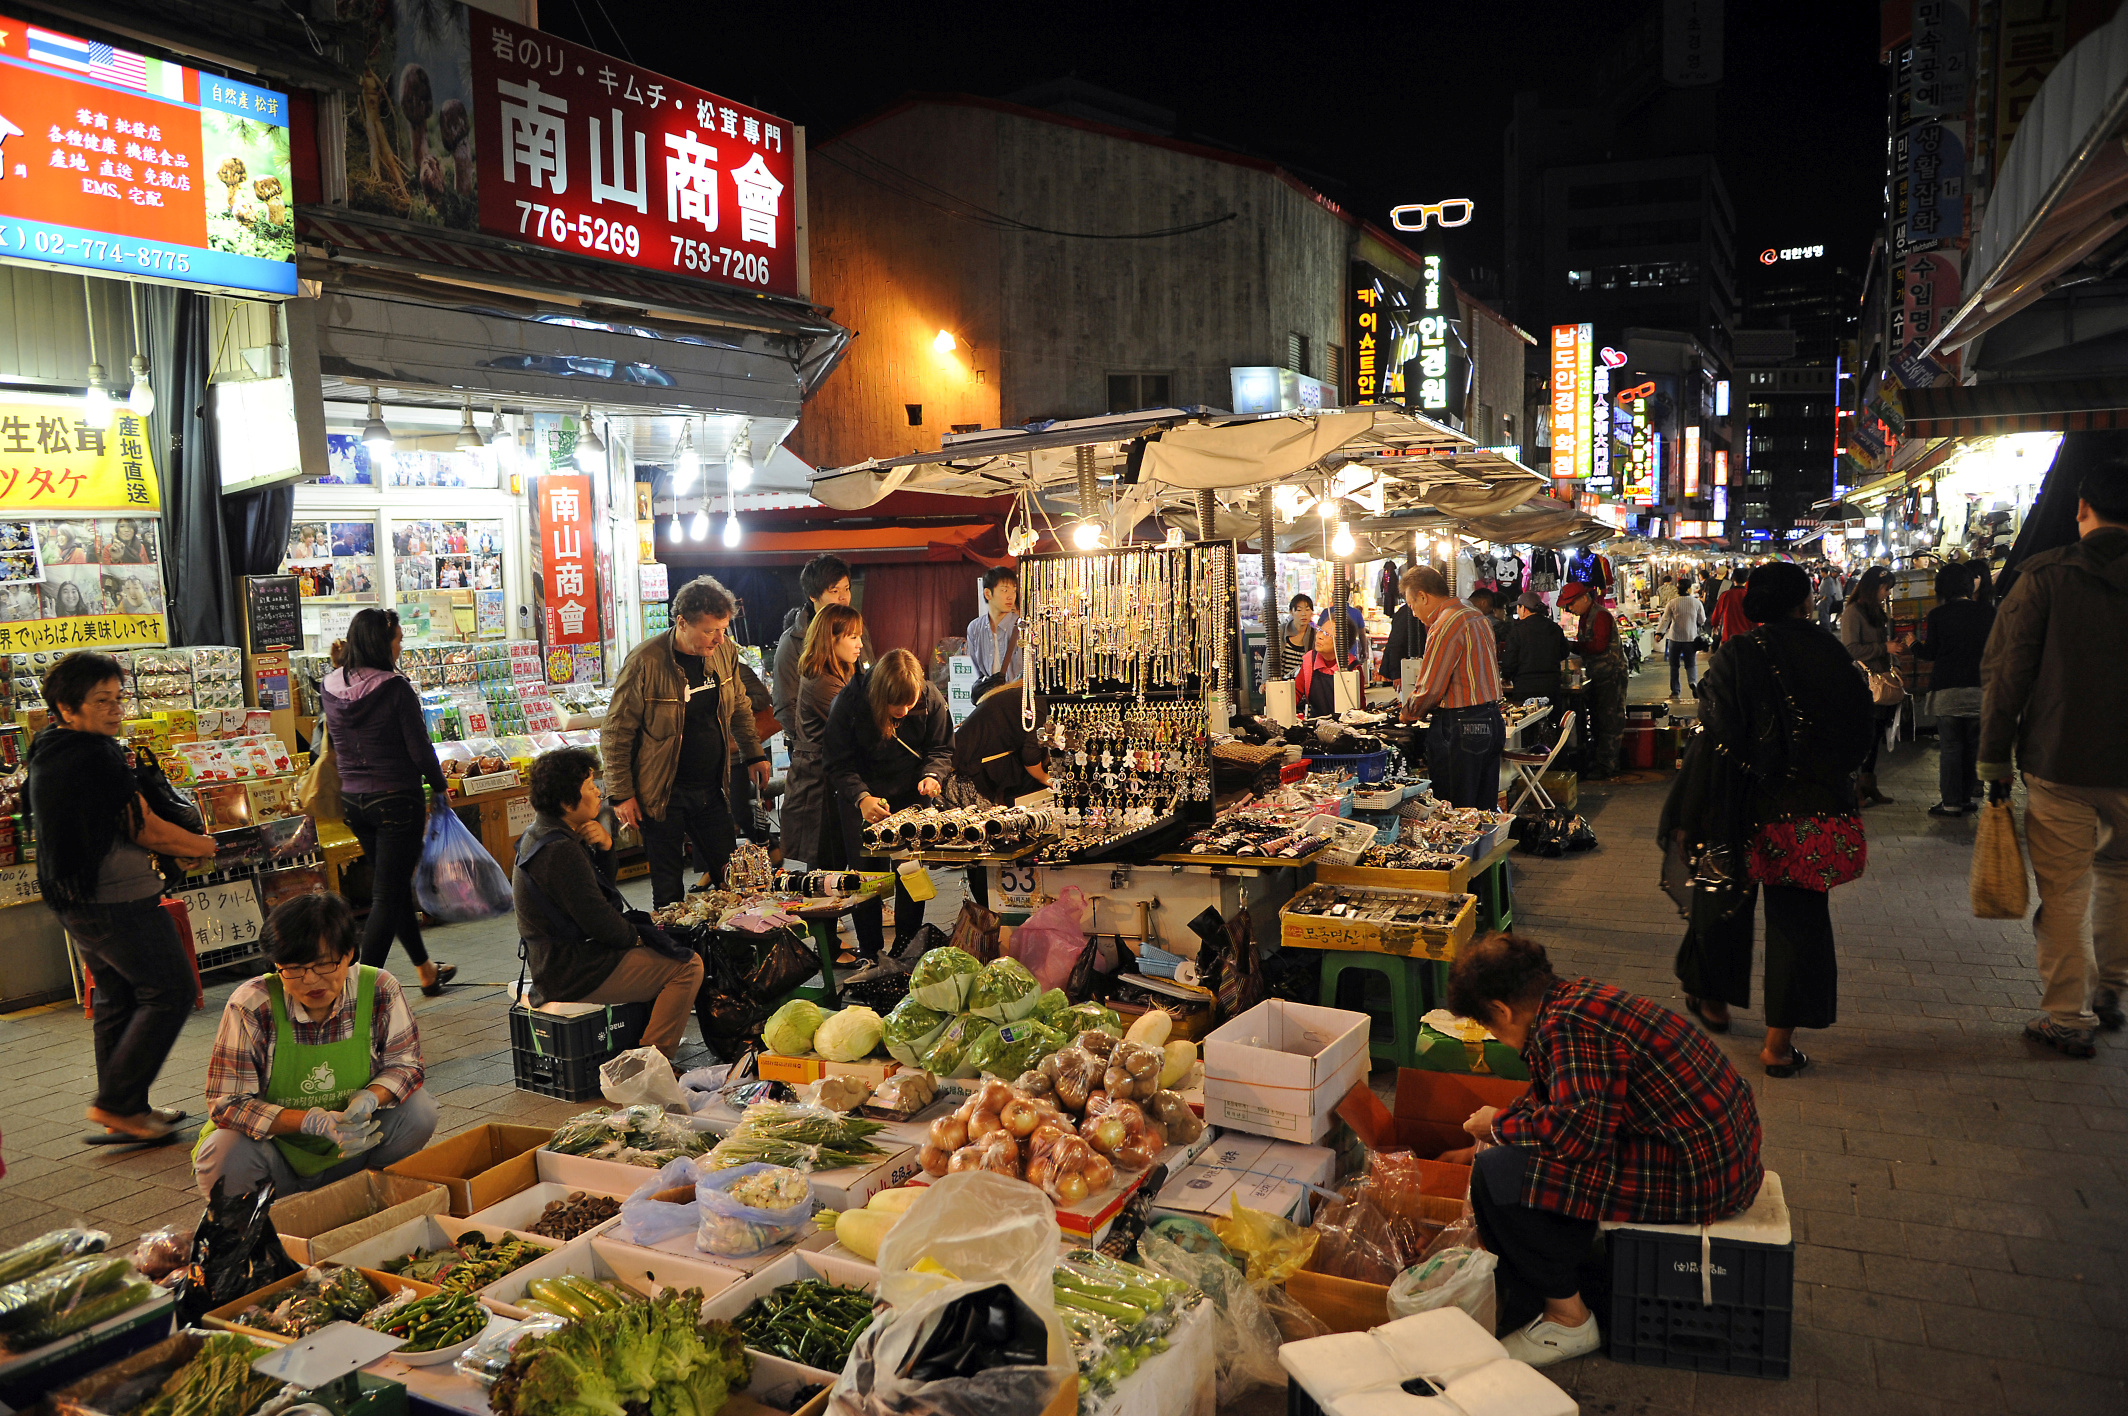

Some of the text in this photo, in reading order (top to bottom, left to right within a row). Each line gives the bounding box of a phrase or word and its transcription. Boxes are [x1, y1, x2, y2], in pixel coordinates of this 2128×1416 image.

[496, 78, 785, 250] 南山商會
[34, 230, 191, 272] 02-774-8775
[514, 199, 771, 286] 776-5269 753-7206
[549, 486, 588, 636] 南山商會
